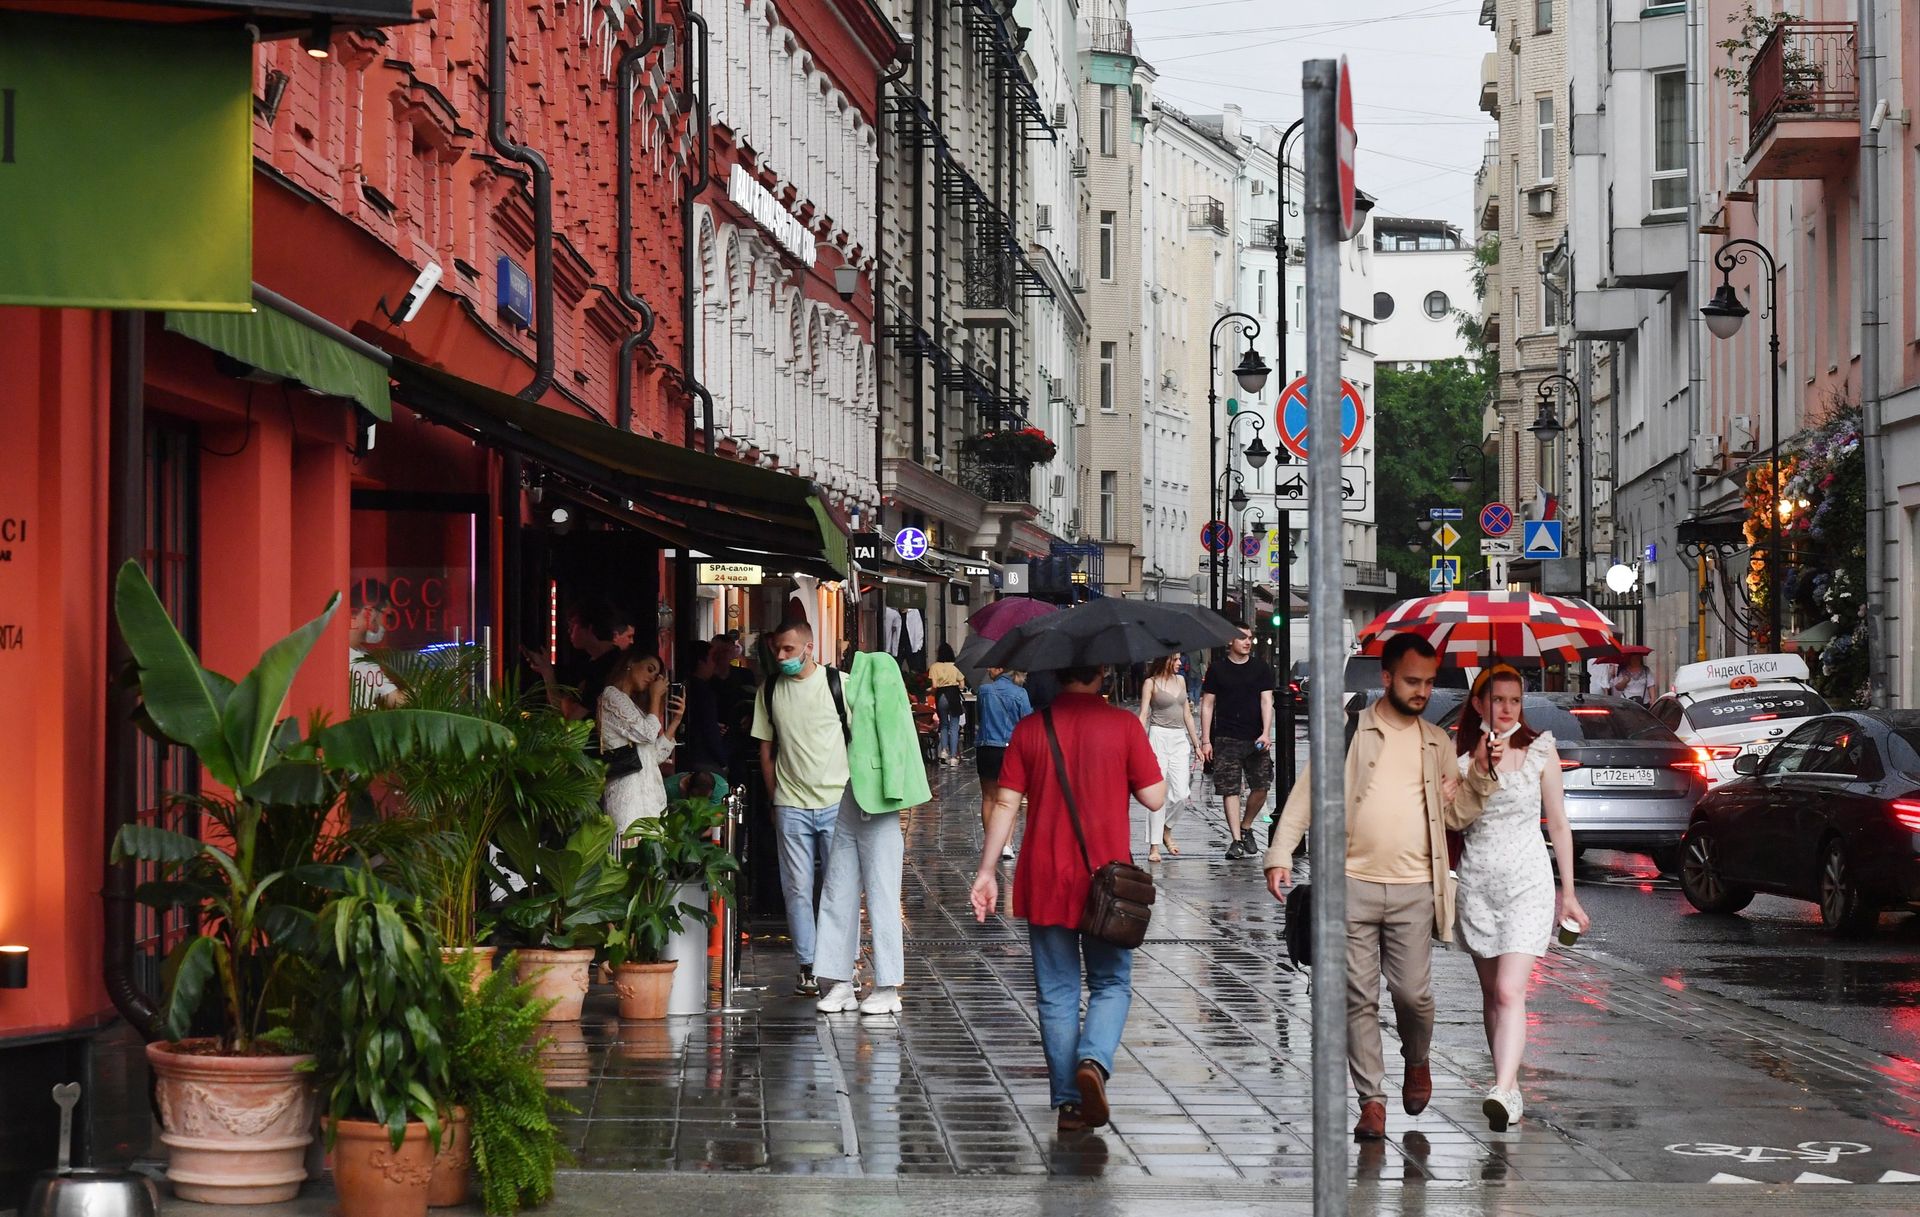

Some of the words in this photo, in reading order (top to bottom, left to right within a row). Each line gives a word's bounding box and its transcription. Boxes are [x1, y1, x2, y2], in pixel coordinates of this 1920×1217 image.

[709, 564, 754, 572] SPA-салон
[714, 574, 726, 582] 24
[1706, 664, 1746, 679] Яндекс
[1747, 659, 1778, 674] Такси
[1712, 699, 1805, 716] 999-99-99
